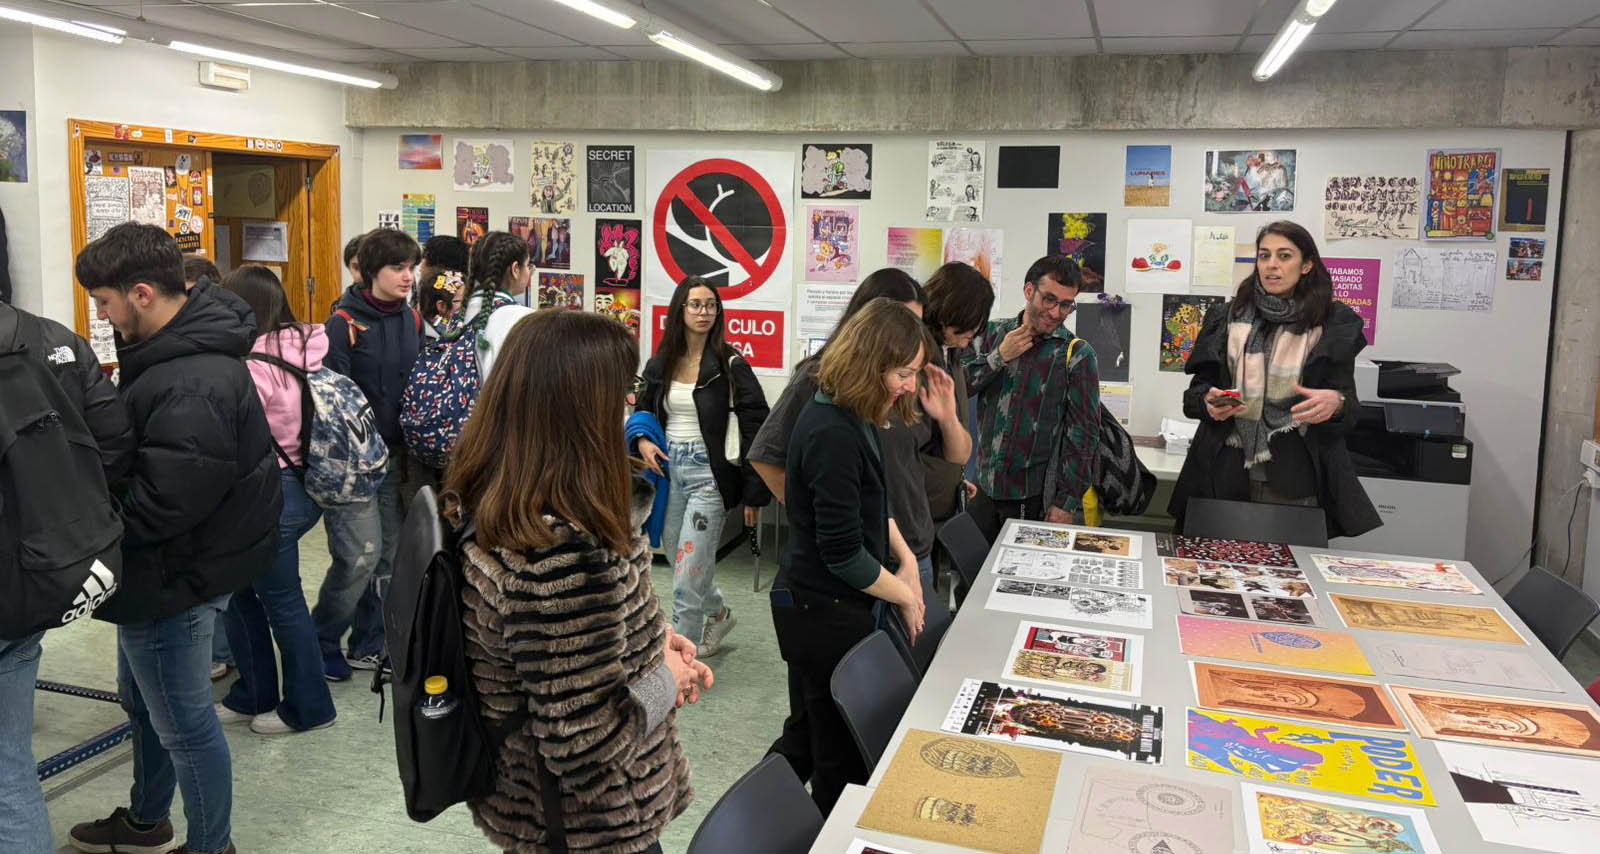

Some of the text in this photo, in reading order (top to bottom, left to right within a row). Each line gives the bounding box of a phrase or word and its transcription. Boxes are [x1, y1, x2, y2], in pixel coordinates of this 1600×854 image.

[588, 150, 632, 161] SECRET
[589, 203, 632, 212] LOCATION
[728, 318, 776, 336] CULO
[1327, 731, 1424, 800] PODER
